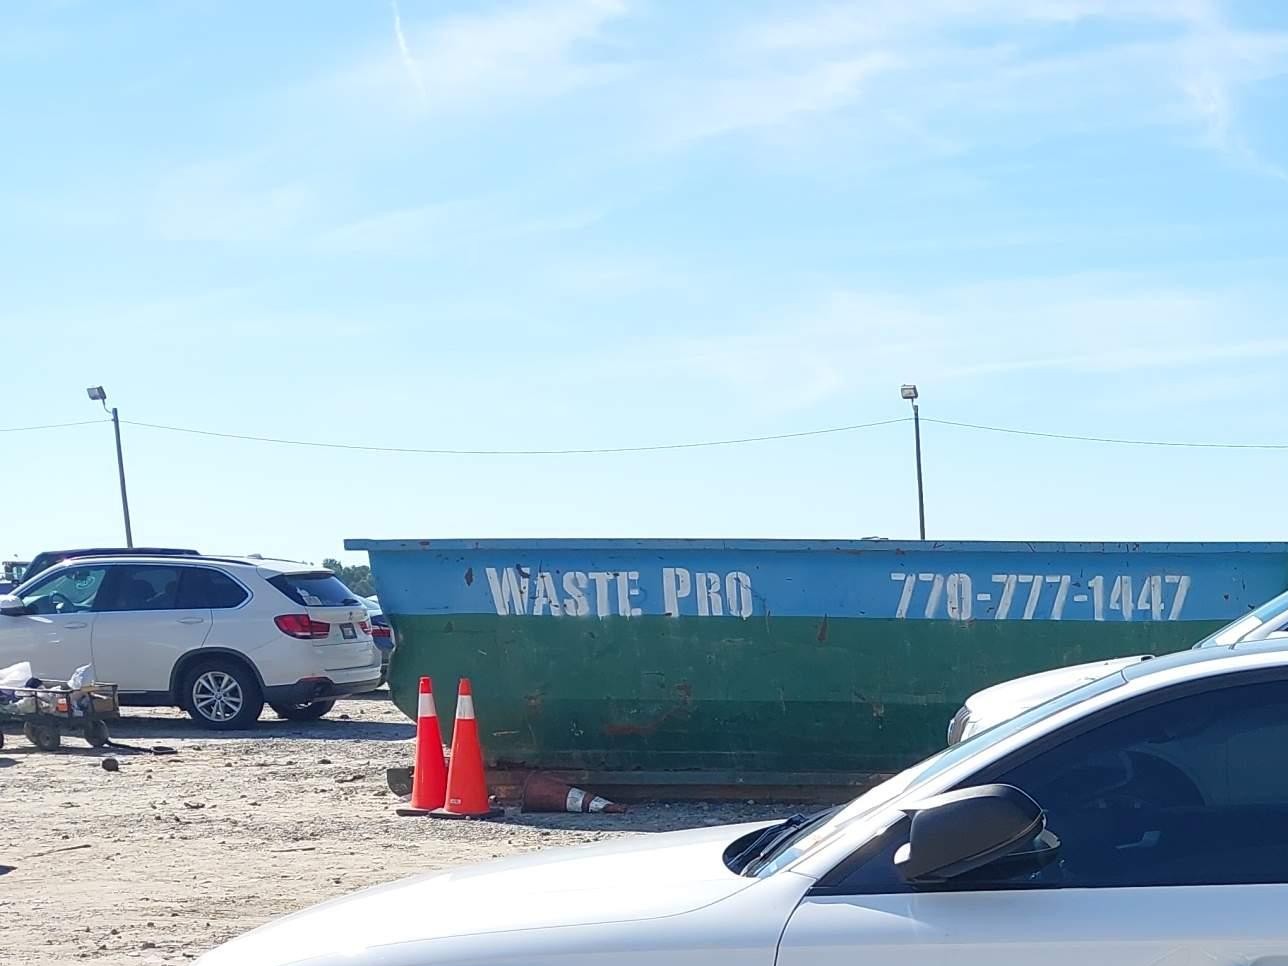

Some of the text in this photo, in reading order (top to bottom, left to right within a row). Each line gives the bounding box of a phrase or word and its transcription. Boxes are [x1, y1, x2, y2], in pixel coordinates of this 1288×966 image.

[485, 567, 753, 619] WASTE PRO
[890, 572, 1191, 621] 770-777-1447
